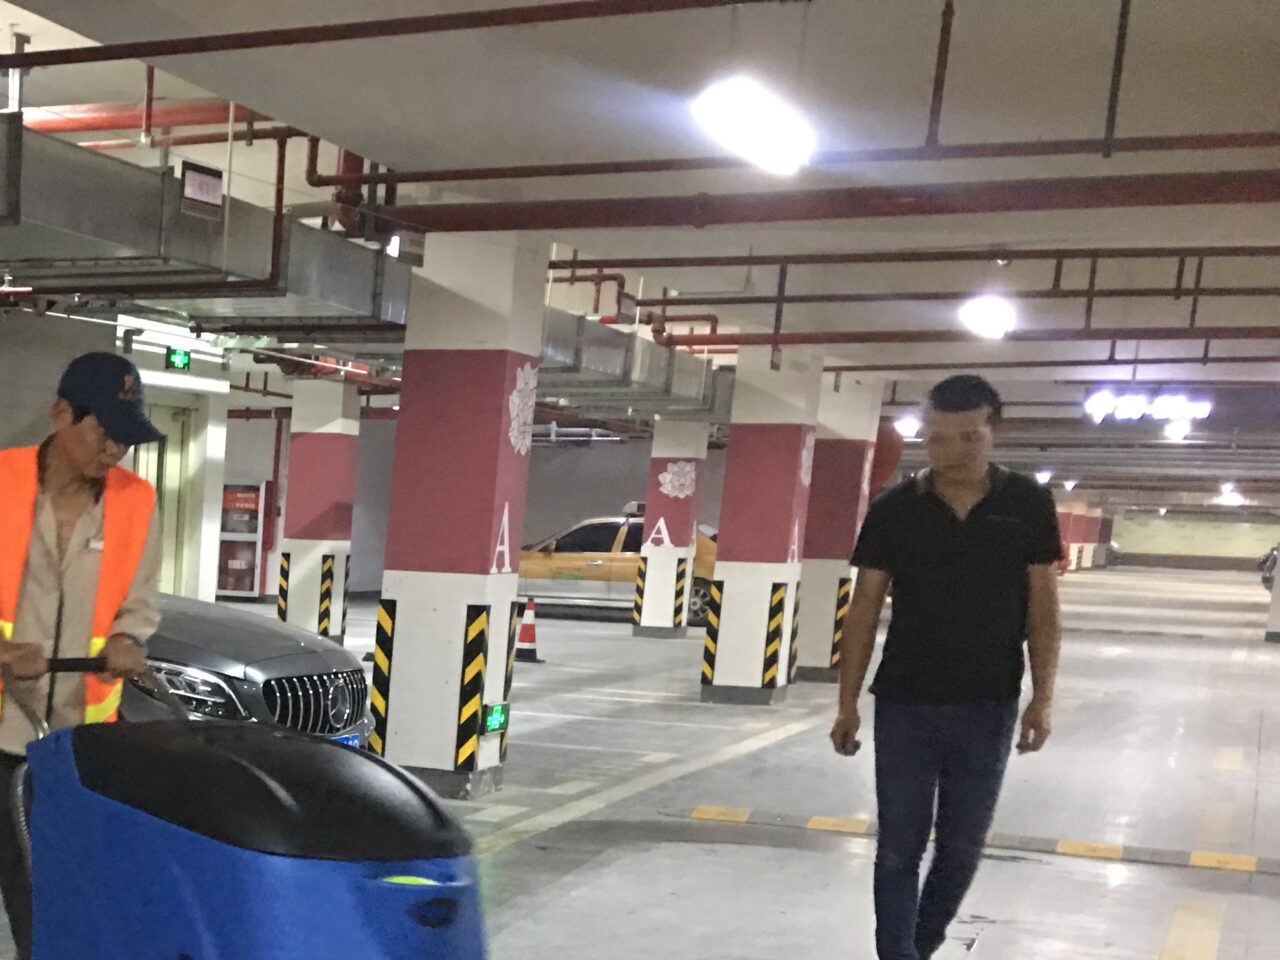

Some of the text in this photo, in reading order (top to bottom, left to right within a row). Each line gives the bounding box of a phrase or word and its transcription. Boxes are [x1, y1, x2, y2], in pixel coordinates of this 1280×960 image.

[490, 501, 512, 574] A
[645, 517, 675, 547] A
[787, 518, 799, 563] A
